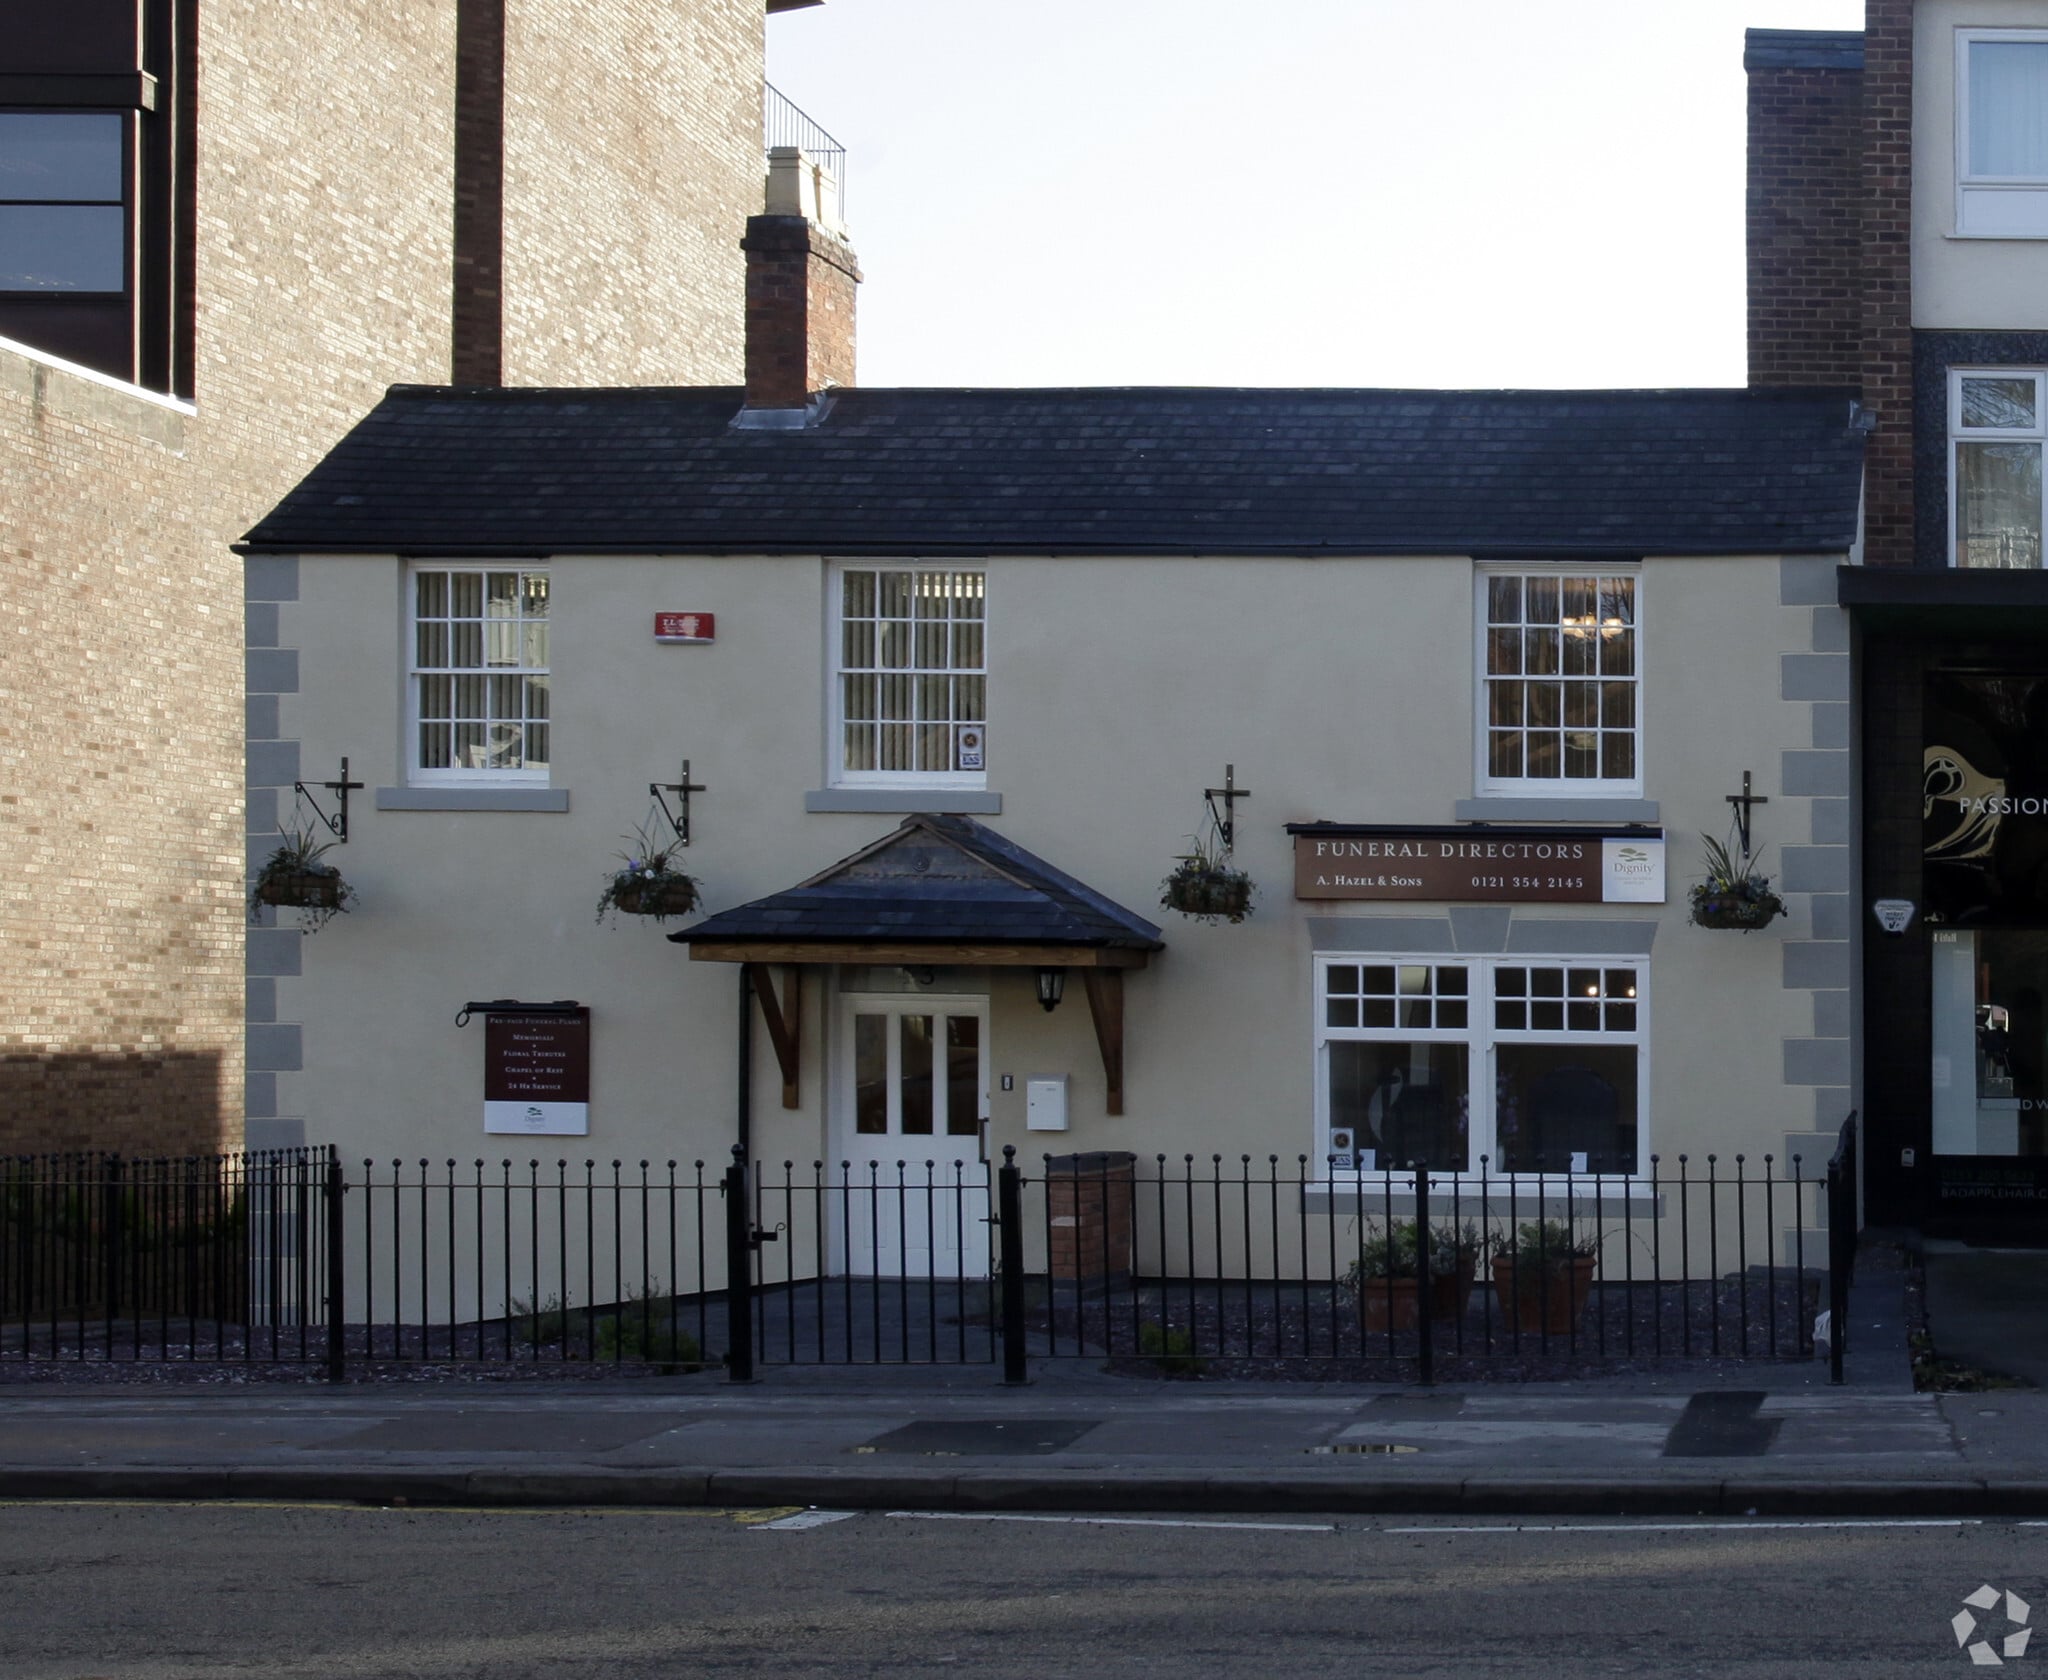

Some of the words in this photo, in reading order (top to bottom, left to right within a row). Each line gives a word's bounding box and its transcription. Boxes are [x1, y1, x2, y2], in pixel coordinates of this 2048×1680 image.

[1316, 842, 1429, 857] FUNERAL
[1440, 843, 1583, 859] DIRECTORS
[1613, 863, 1654, 874] Dignity
[1316, 875, 1330, 886] A.
[1377, 875, 1387, 886] &
[1472, 876, 1504, 888] 0121
[1512, 877, 1540, 888] 354
[1547, 877, 1583, 888] 2145
